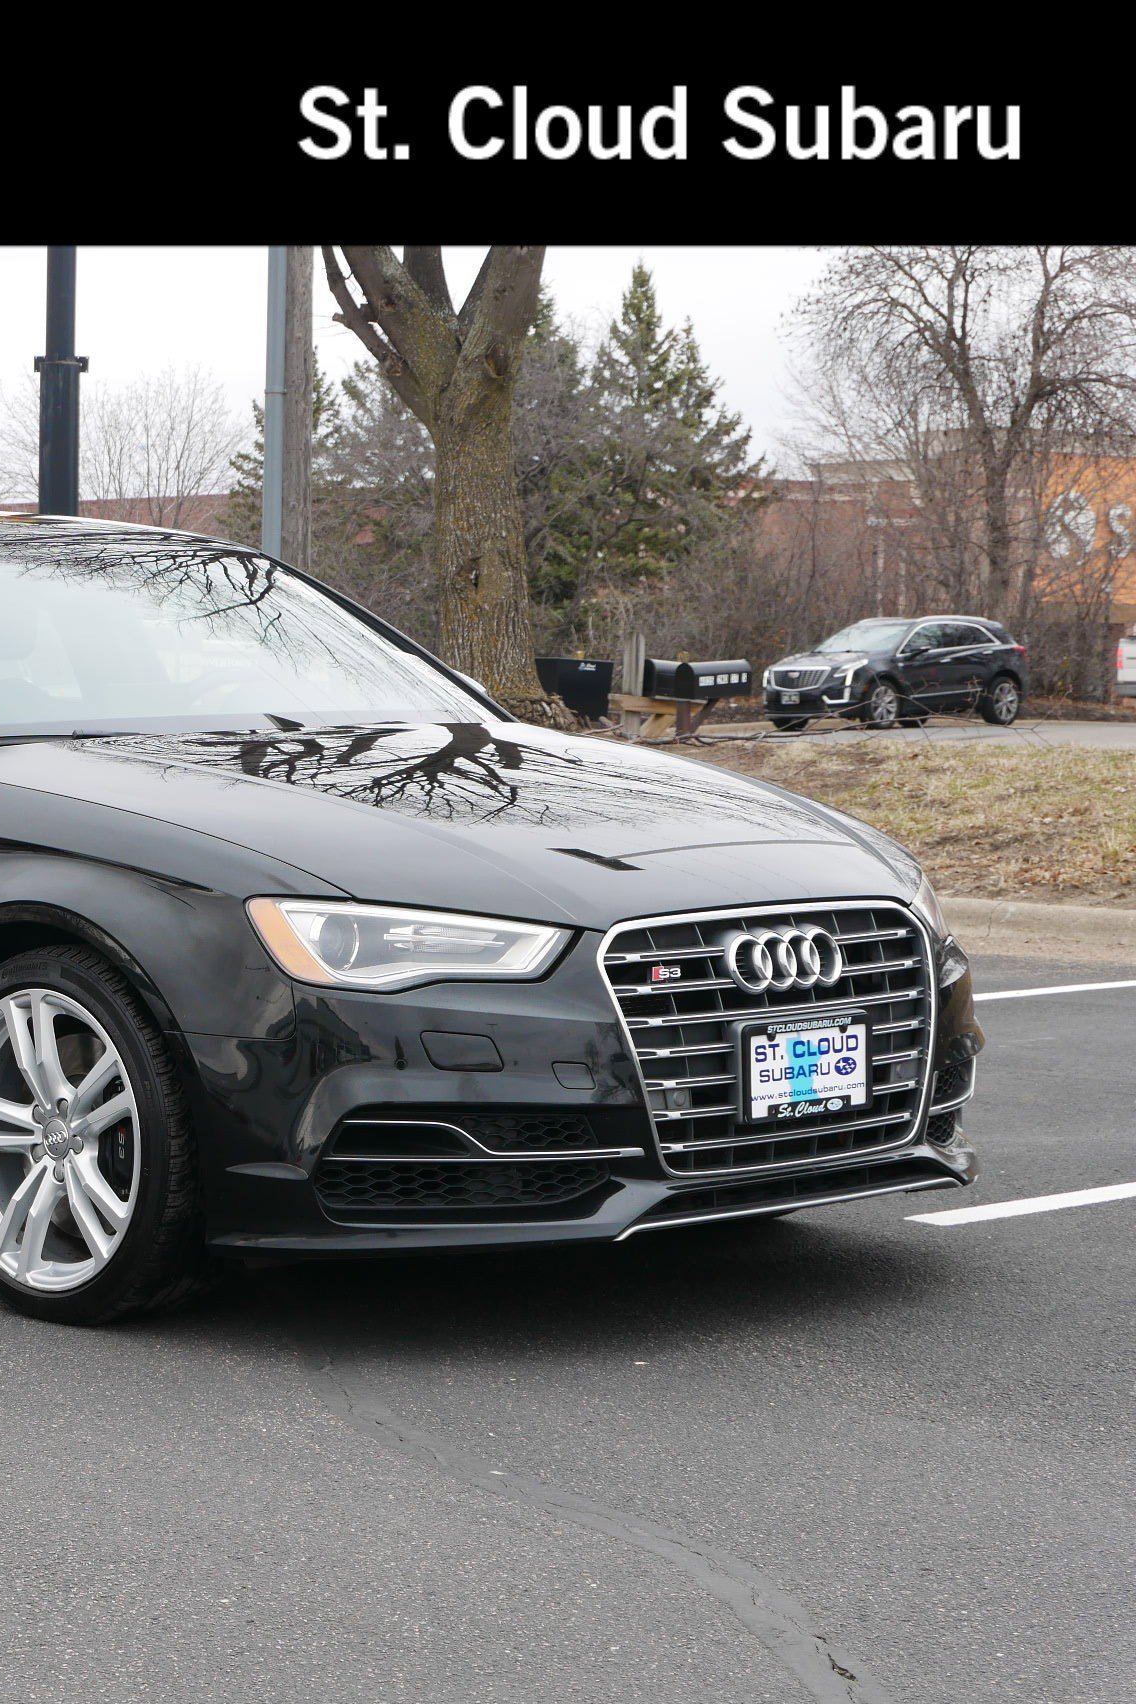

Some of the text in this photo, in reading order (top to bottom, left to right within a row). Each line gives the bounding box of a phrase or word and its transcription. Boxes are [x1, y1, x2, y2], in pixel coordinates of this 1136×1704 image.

[659, 967, 681, 979] S3
[767, 1017, 852, 1034] STCLOUDSUBARU.COM
[754, 1034, 859, 1063] ST. CLOUD
[759, 1062, 831, 1083] SUBARU
[751, 1081, 865, 1102] www.stcloudsubaru.com
[777, 1100, 826, 1118] St. Cloud
